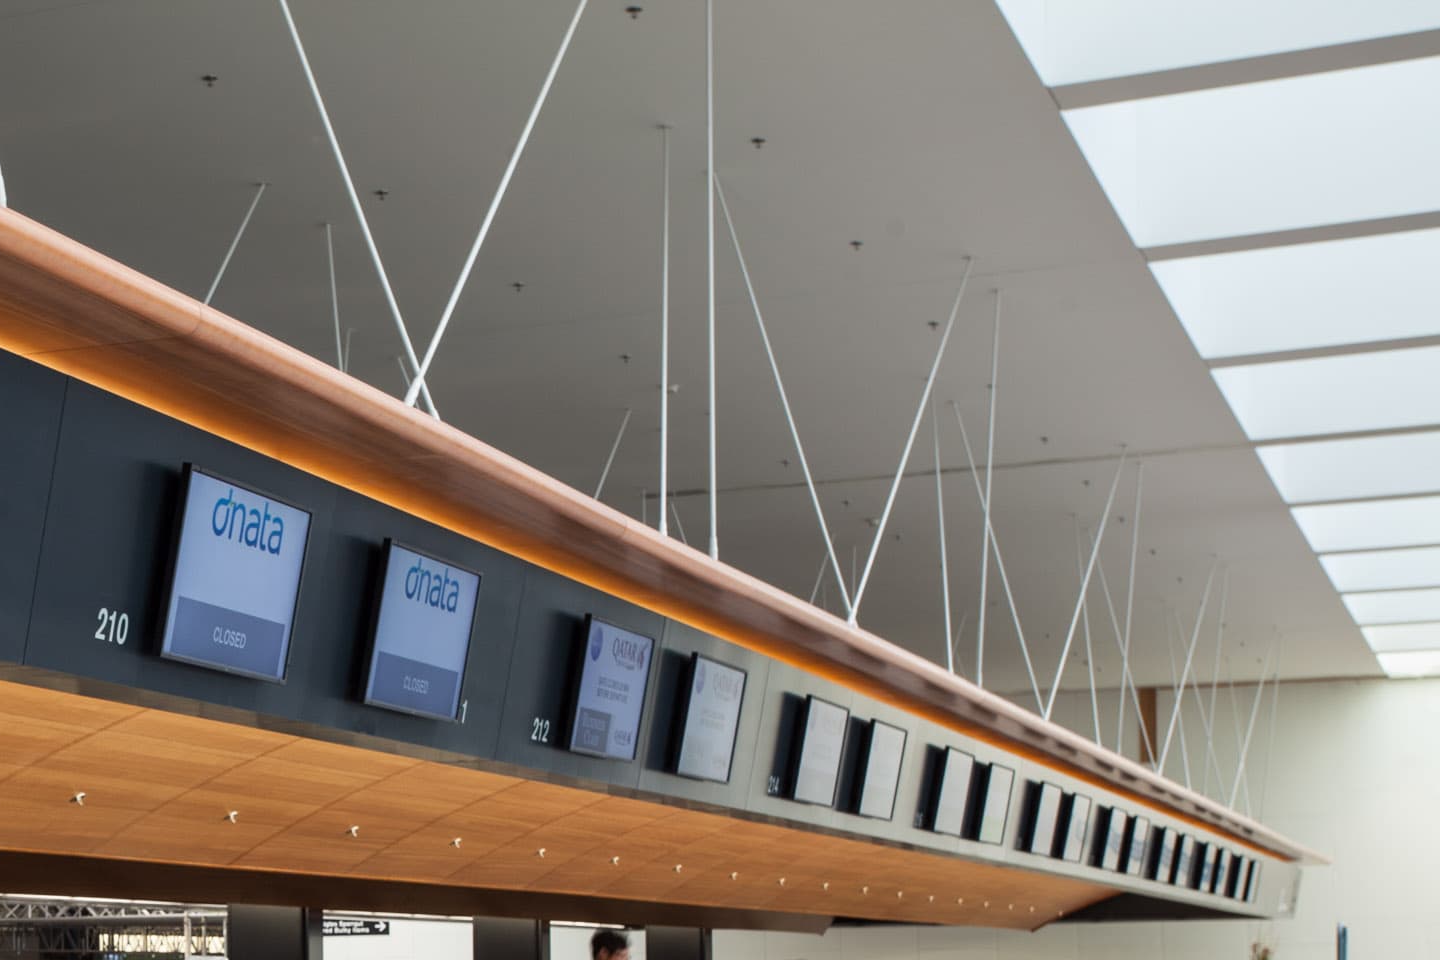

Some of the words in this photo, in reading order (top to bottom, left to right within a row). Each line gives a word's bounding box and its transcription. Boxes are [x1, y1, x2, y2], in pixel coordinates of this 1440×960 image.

[212, 488, 284, 556] dnata
[405, 557, 460, 613] dnata
[94, 607, 129, 646] 210
[213, 626, 247, 649] CLOSED
[403, 675, 430, 695] CLOSED
[531, 717, 550, 743] 212
